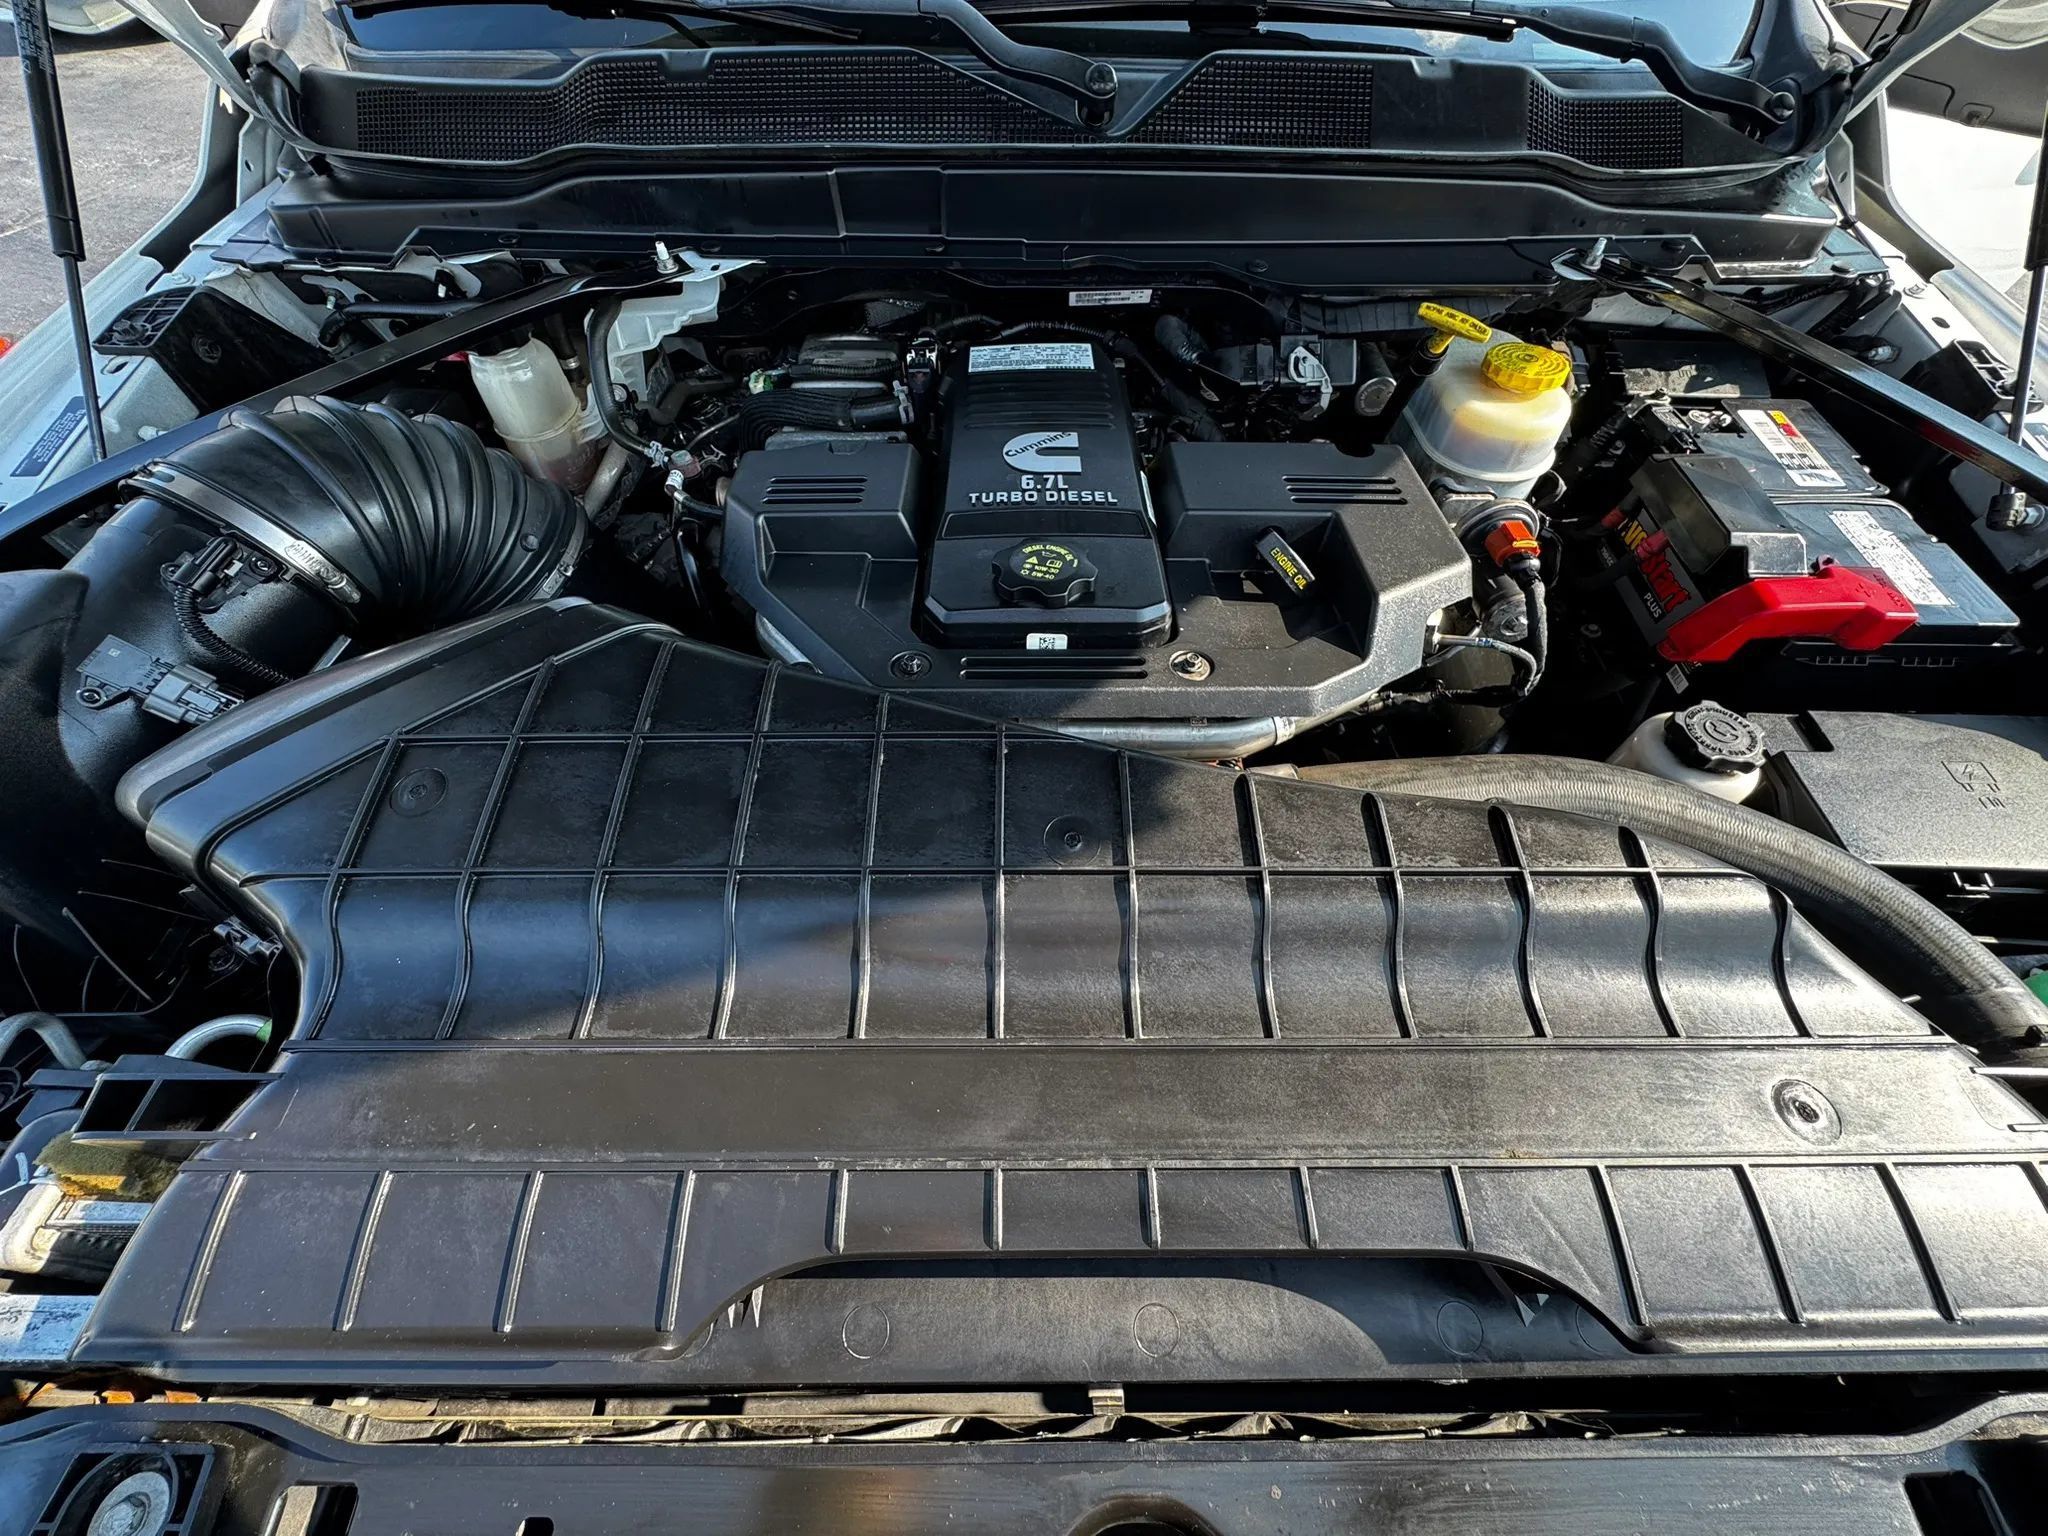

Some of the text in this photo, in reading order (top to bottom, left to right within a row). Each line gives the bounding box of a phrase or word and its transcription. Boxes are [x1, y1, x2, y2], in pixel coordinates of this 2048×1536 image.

[1004, 432, 1072, 458] Cummins
[1021, 474, 1069, 490] 6.7L
[969, 490, 1118, 504] TURBO DIESEL
[1022, 544, 1045, 554] DIESEL
[1045, 544, 1070, 556] ENGINE
[1031, 571, 1055, 580] 5W-40
[1034, 565, 1060, 574] 10W-30
[1270, 547, 1307, 590] ENGINE OIL
[1643, 592, 1662, 618] PLUS
